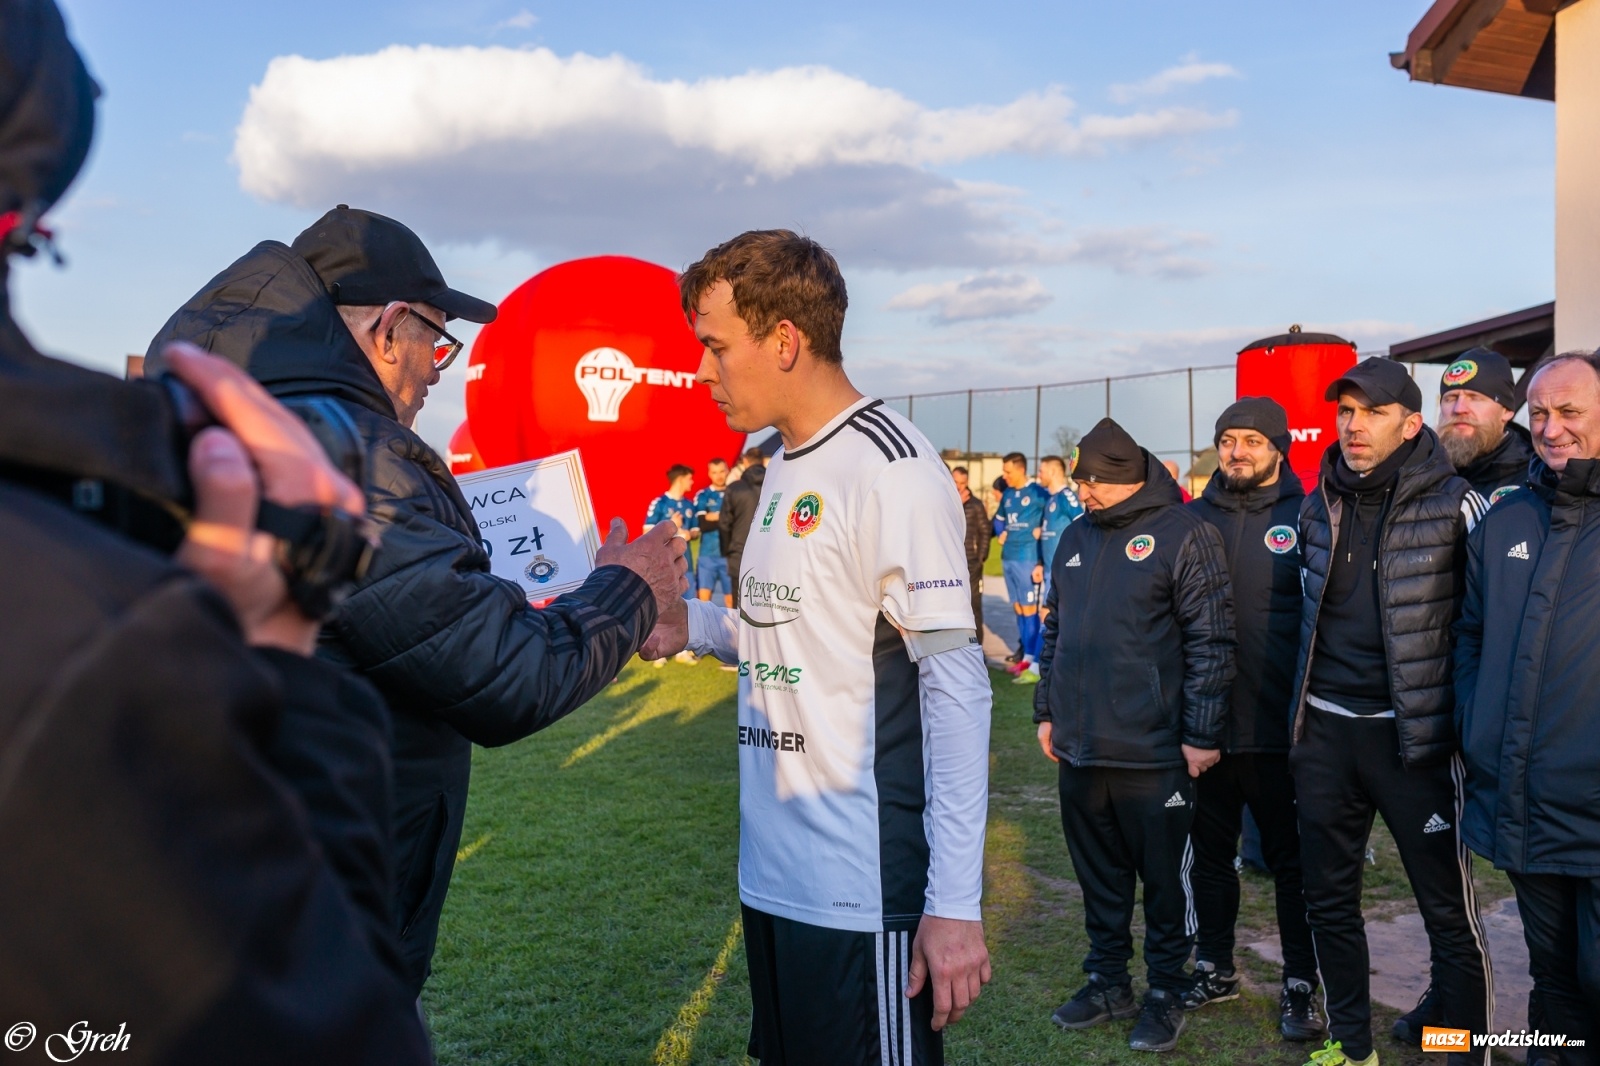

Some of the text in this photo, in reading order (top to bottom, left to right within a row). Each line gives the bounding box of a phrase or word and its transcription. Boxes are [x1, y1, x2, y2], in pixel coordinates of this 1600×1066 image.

[580, 366, 696, 389] POLTENT
[508, 525, 545, 557] zł
[744, 576, 802, 606] REKPOL
[738, 726, 806, 753] ENINGER
[1164, 800, 1187, 808] adidas
[1423, 822, 1451, 833] adidas
